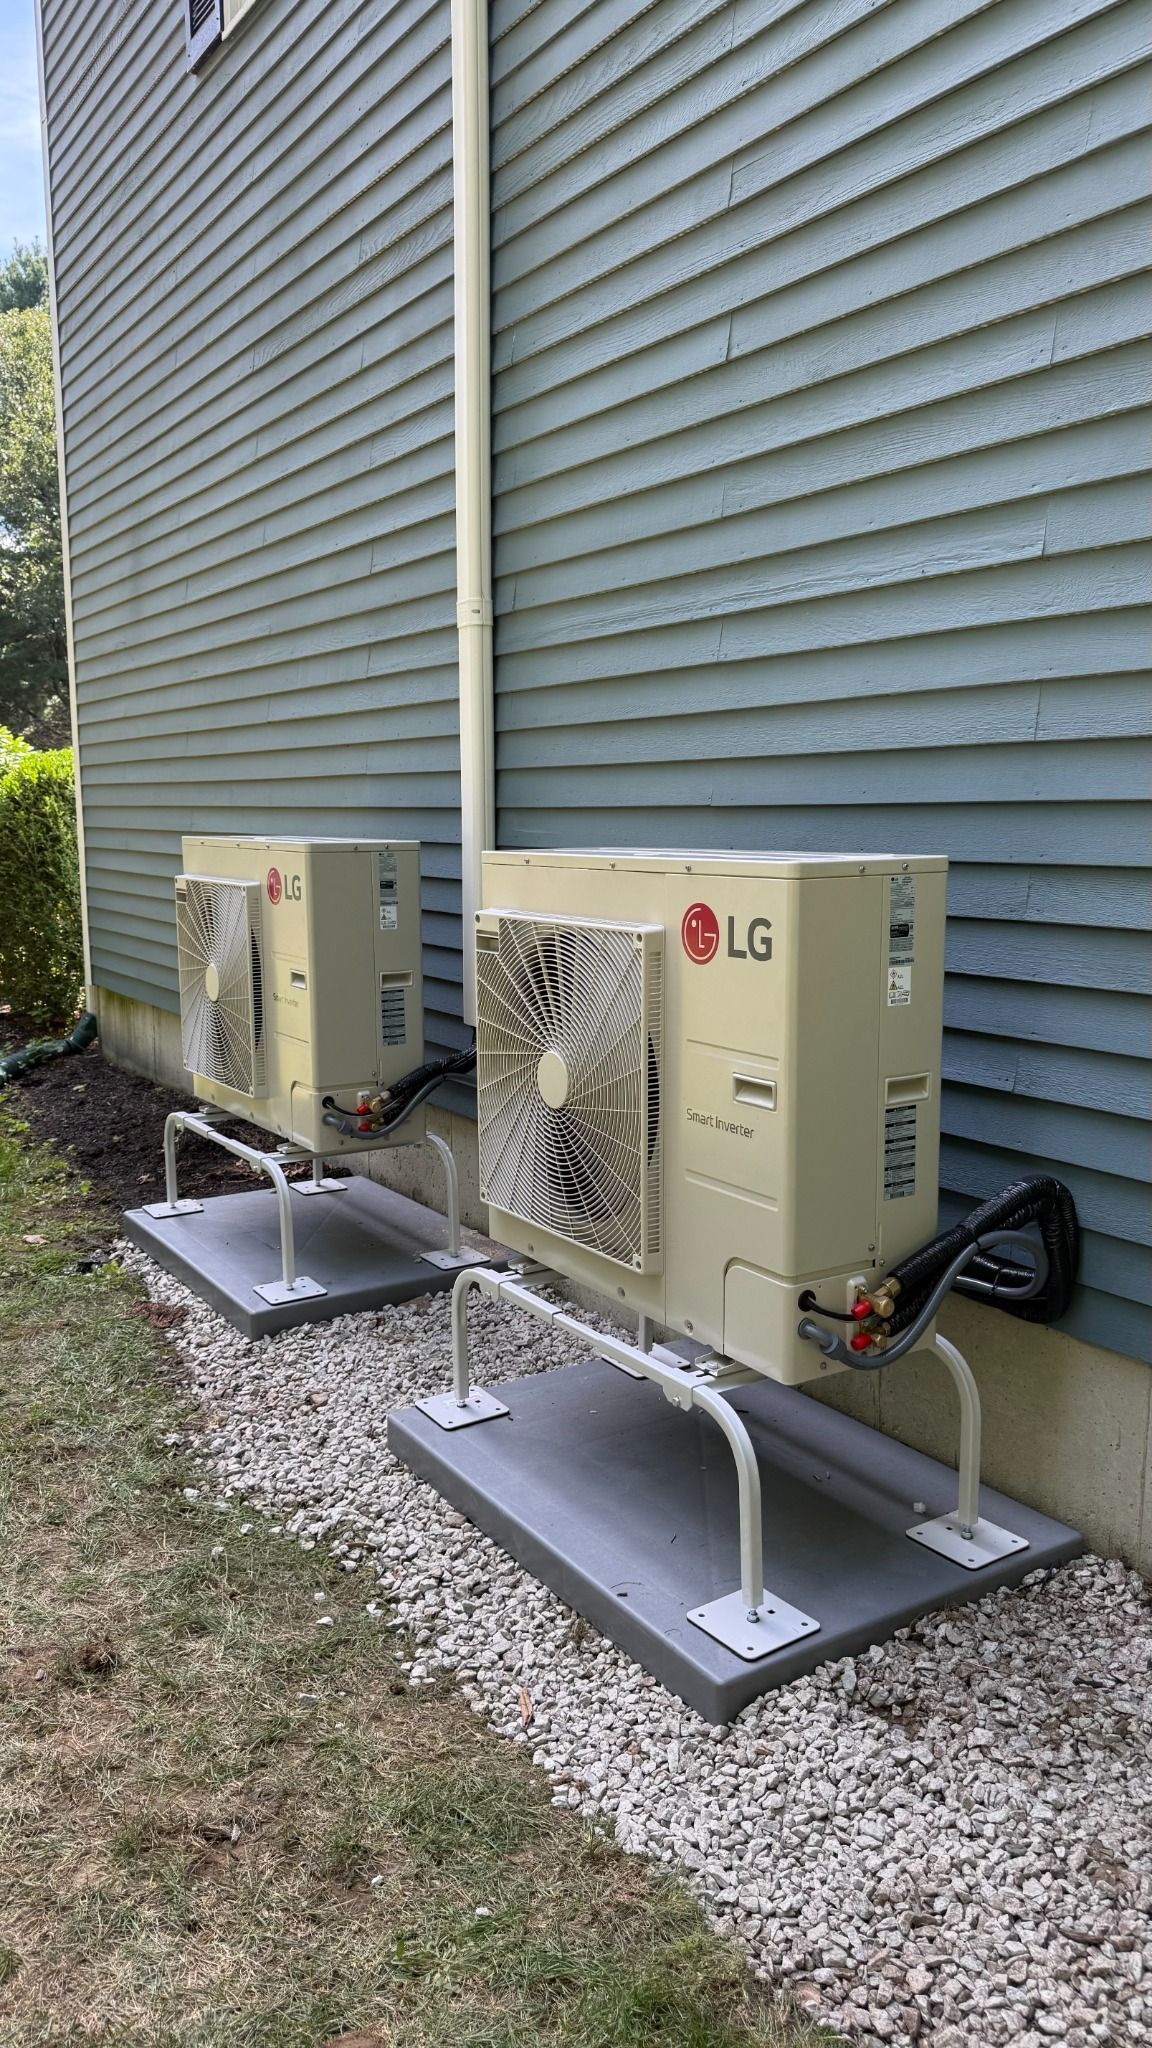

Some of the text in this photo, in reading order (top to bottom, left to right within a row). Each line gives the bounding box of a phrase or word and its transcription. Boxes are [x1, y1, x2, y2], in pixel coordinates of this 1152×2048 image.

[284, 874, 301, 901] LG
[728, 916, 772, 961] LG
[687, 1108, 754, 1138] Smart Inverter
